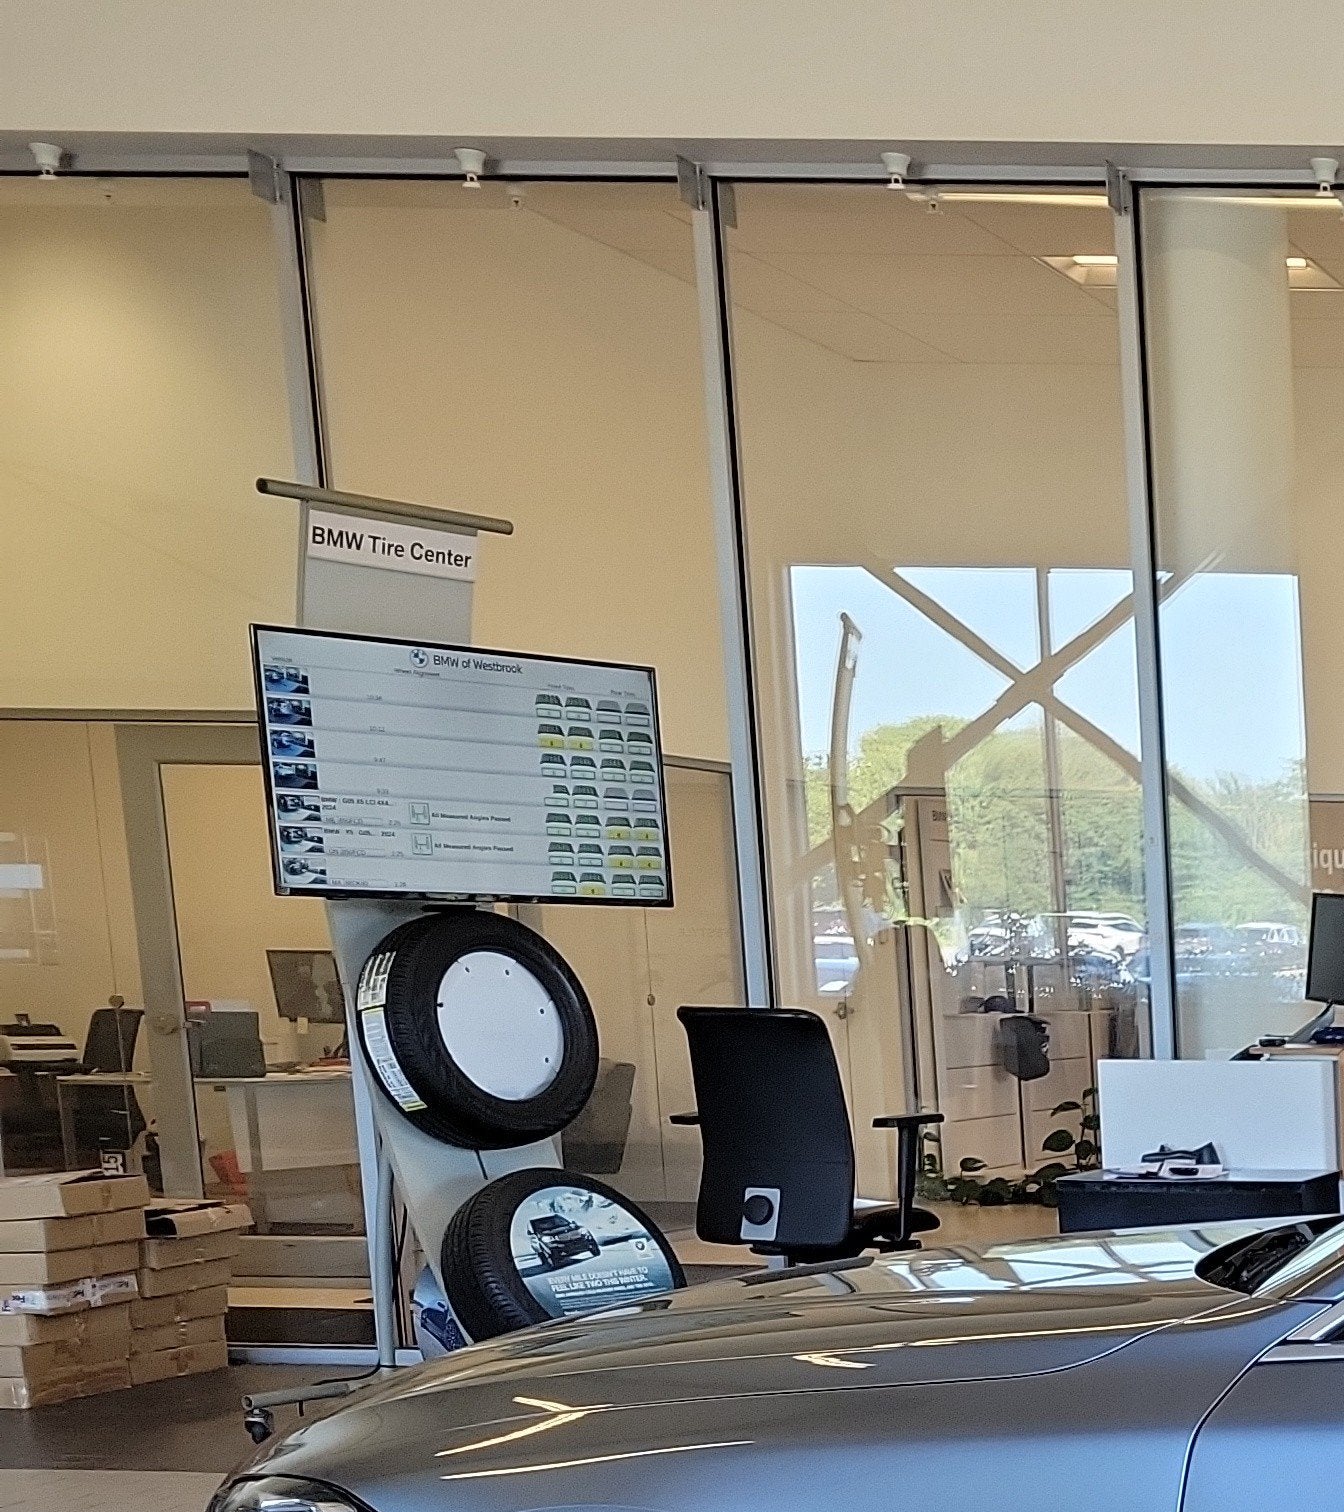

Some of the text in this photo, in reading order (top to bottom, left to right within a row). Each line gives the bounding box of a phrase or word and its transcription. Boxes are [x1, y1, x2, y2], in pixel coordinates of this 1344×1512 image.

[311, 525, 472, 568] BMW Tire Center
[433, 654, 524, 674] BMW of Westbrook
[639, 1266, 649, 1274] TO
[551, 1283, 570, 1292] FEEL
[569, 1281, 585, 1290] LIKE
[585, 1279, 603, 1289] TWO
